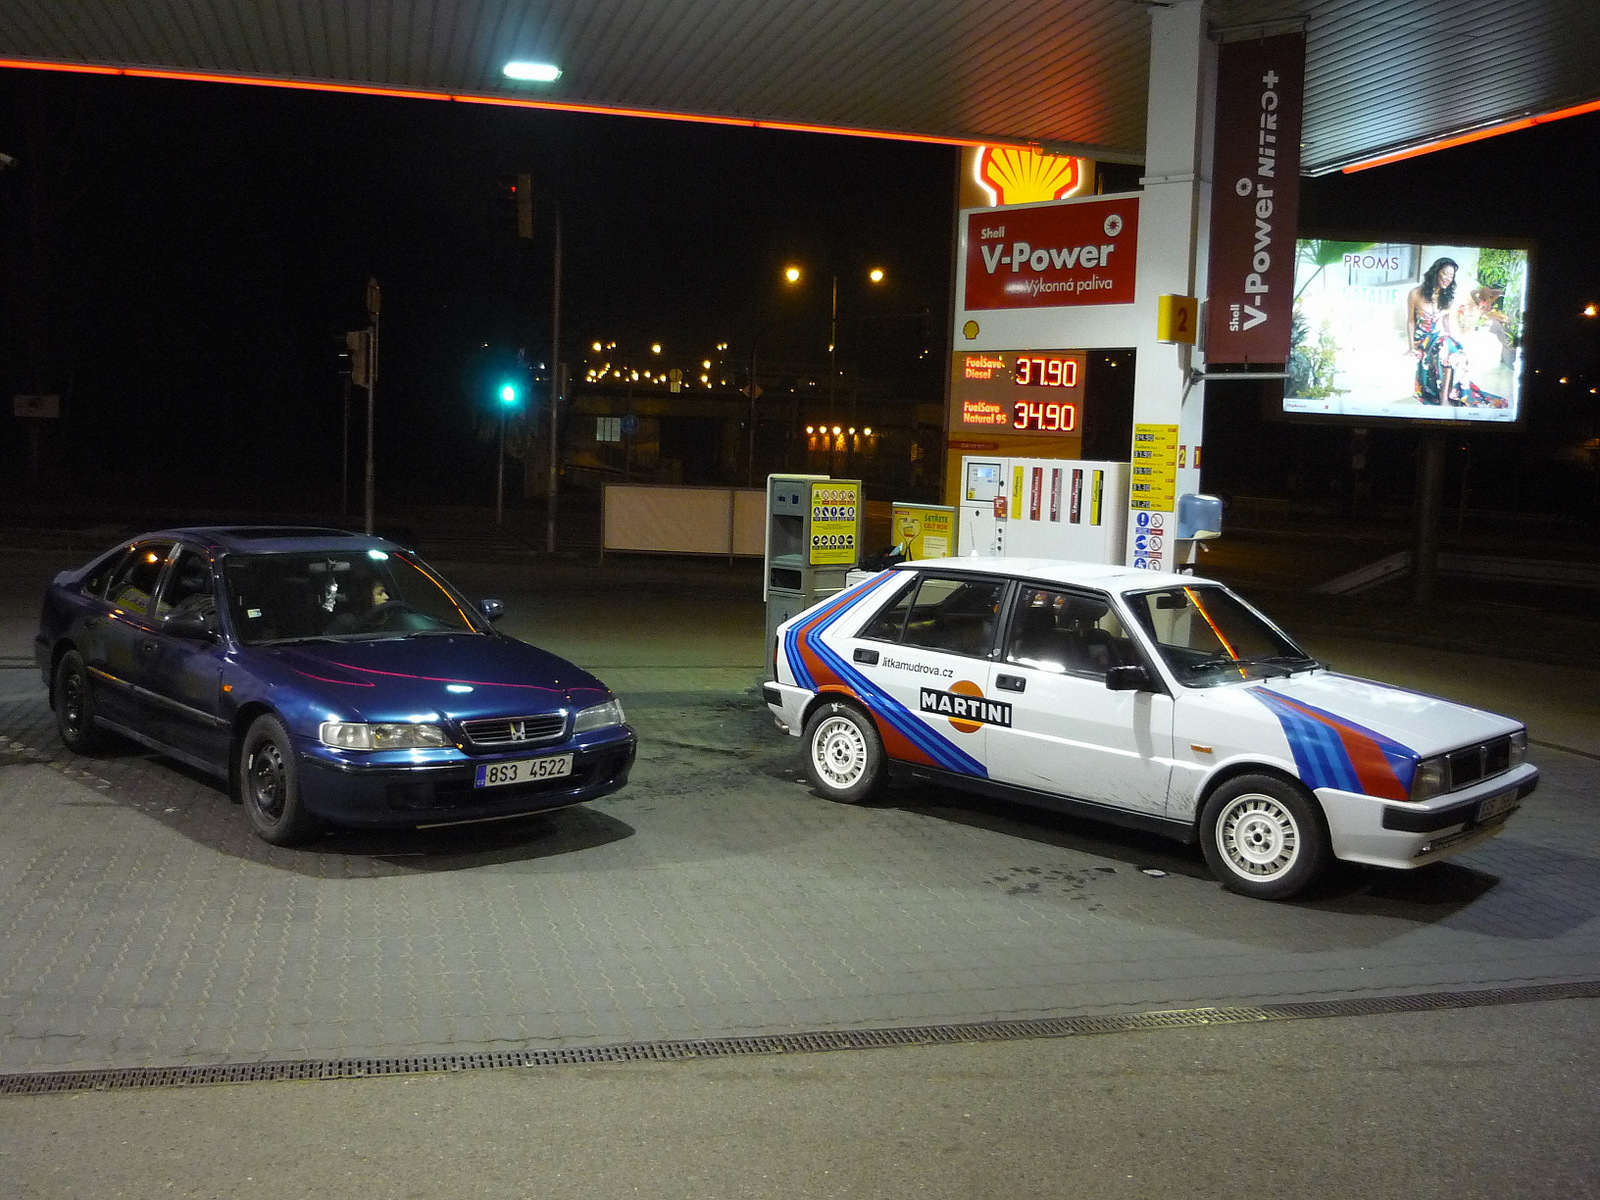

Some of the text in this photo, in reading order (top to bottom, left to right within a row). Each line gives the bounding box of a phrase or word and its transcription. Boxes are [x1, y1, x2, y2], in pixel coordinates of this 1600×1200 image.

[981, 226, 1005, 240] Shell
[980, 242, 1115, 274] V-Power
[1243, 183, 1275, 332] V-Power
[1343, 254, 1399, 271] PROMS
[1025, 274, 1113, 297] Výkonná paliva
[1177, 307, 1188, 332] 2
[1229, 303, 1241, 332] Shell
[965, 355, 1002, 369] FuelSave
[965, 368, 992, 379] Diesel
[1016, 358, 1077, 387] 37.90
[963, 401, 1000, 413] FuelSave
[963, 413, 1007, 424] Natural 95
[1013, 402, 1075, 431] 34.90
[1179, 449, 1186, 465] 2
[921, 691, 1010, 724] MARTINI
[489, 758, 566, 783] 8S3 4522
